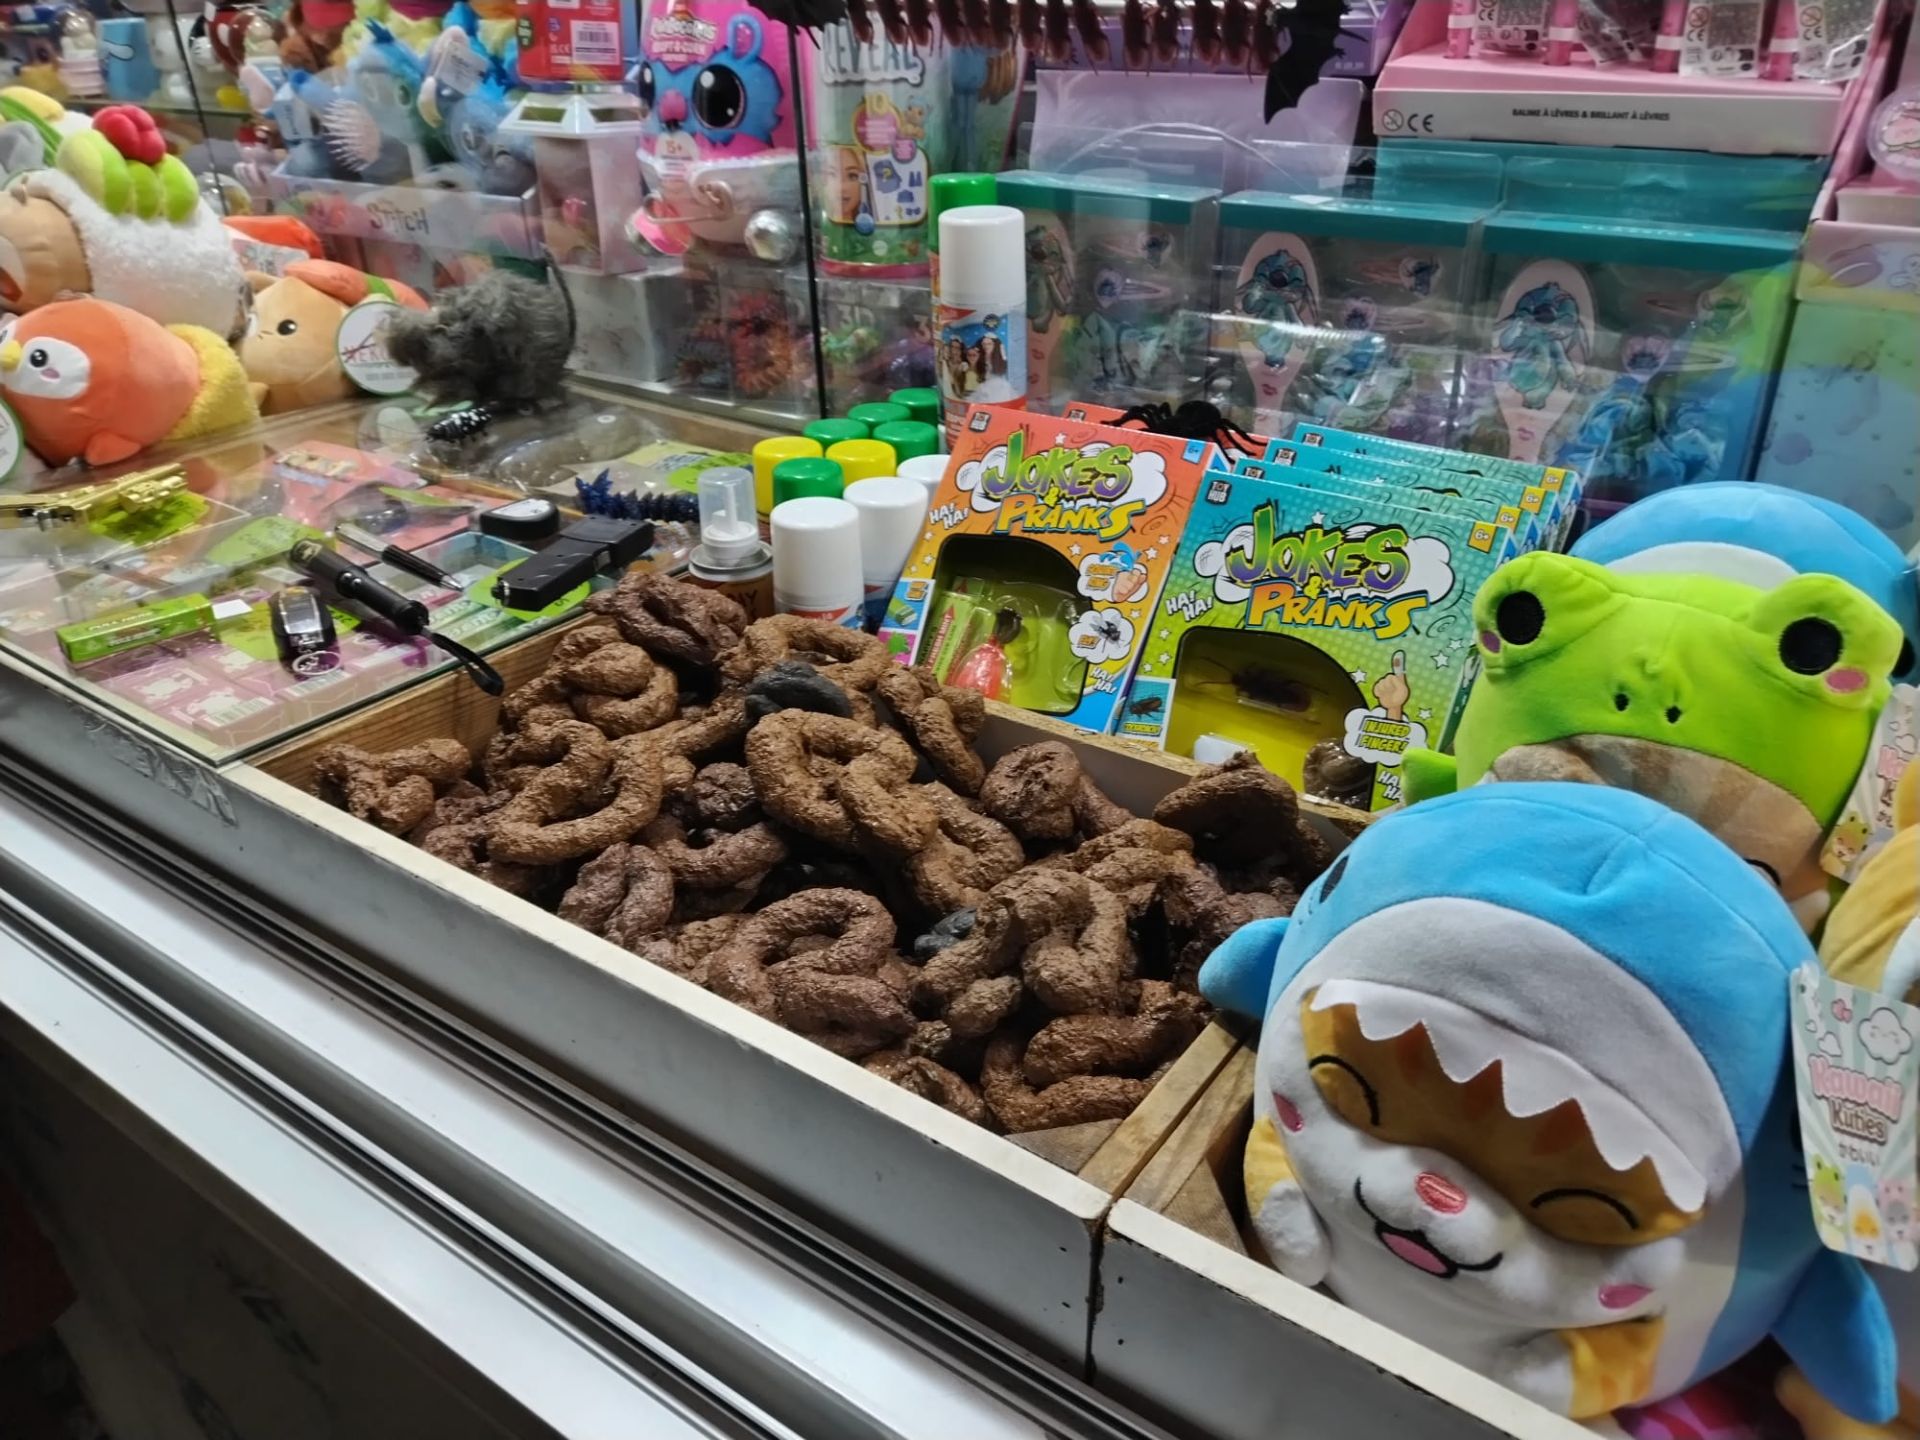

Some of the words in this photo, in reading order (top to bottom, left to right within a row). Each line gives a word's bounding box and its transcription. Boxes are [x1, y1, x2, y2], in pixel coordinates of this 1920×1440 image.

[1512, 108, 1541, 117] BAUME
[1590, 110, 1629, 120] BRILLANT
[982, 429, 1134, 499] JOKES
[1044, 484, 1059, 506] &
[1207, 490, 1228, 503] HUB
[1212, 481, 1231, 491] TOY
[1526, 494, 1539, 504] 6+
[929, 503, 954, 525] HA!
[943, 508, 969, 529] HA!
[995, 493, 1145, 541] PRANKS
[1500, 512, 1514, 522] 6+
[1475, 529, 1489, 540] 6+
[1225, 504, 1410, 592] JOKES
[1303, 576, 1322, 599] &
[1166, 590, 1195, 615] HA!
[1182, 597, 1212, 621] HA!
[1247, 580, 1430, 639] PRANKS
[1362, 718, 1411, 737] INJURED
[1360, 735, 1409, 754] FINGER!
[1809, 1055, 1901, 1122] Kawaii
[1832, 1102, 1886, 1139] Kuties
